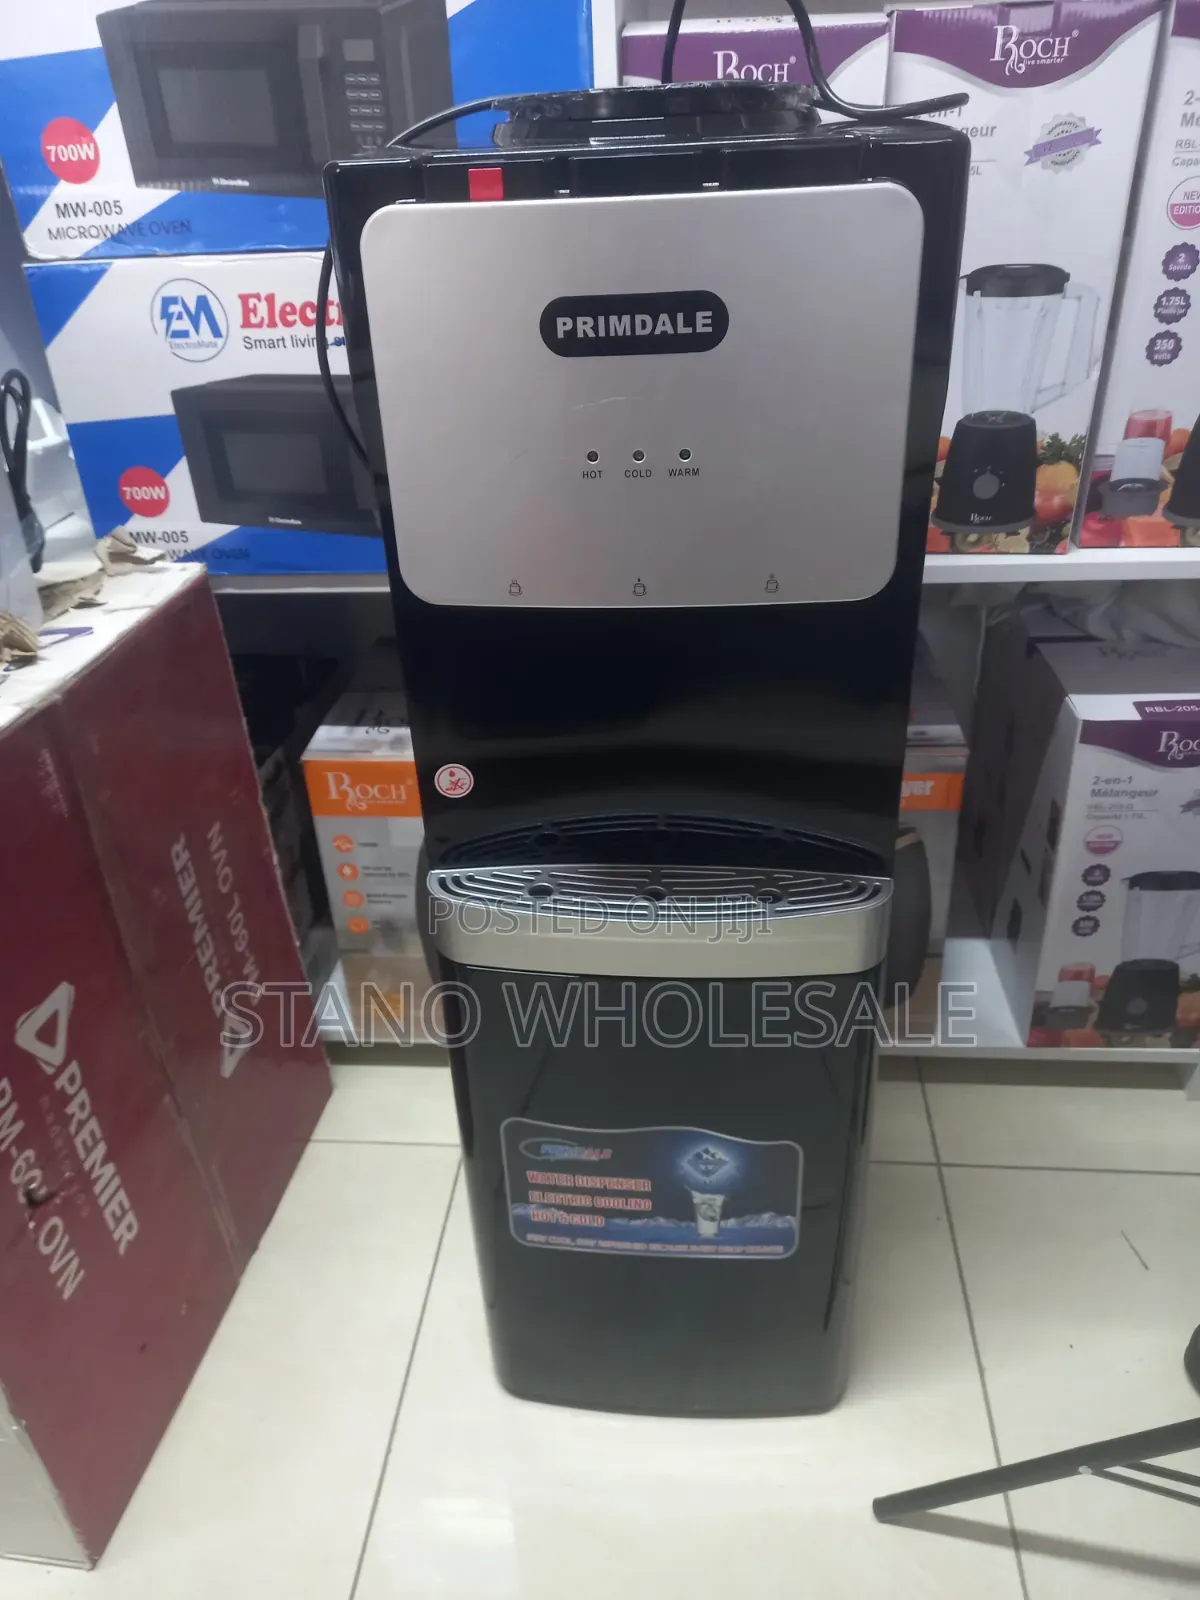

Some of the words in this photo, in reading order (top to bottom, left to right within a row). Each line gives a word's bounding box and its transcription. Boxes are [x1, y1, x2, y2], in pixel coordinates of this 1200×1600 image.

[46, 142, 95, 163] 700W
[55, 200, 123, 219] MW-005
[48, 222, 146, 240] MICROWAVE
[148, 219, 193, 237] OVEN
[1160, 296, 1187, 306] 1.75L
[556, 310, 713, 339] PRIMDALE
[242, 336, 287, 351] Smart
[582, 470, 603, 479] HOT
[624, 469, 652, 478] COLD
[668, 468, 700, 477] WARM
[122, 486, 166, 501] 700W
[129, 531, 189, 544] MW-005
[1092, 775, 1133, 786] 2-en-1
[54, 1059, 139, 1257] PREMIER
[526, 1170, 574, 1188] WATER
[575, 1174, 652, 1192] DISPENSER
[593, 1195, 652, 1211] COOLING
